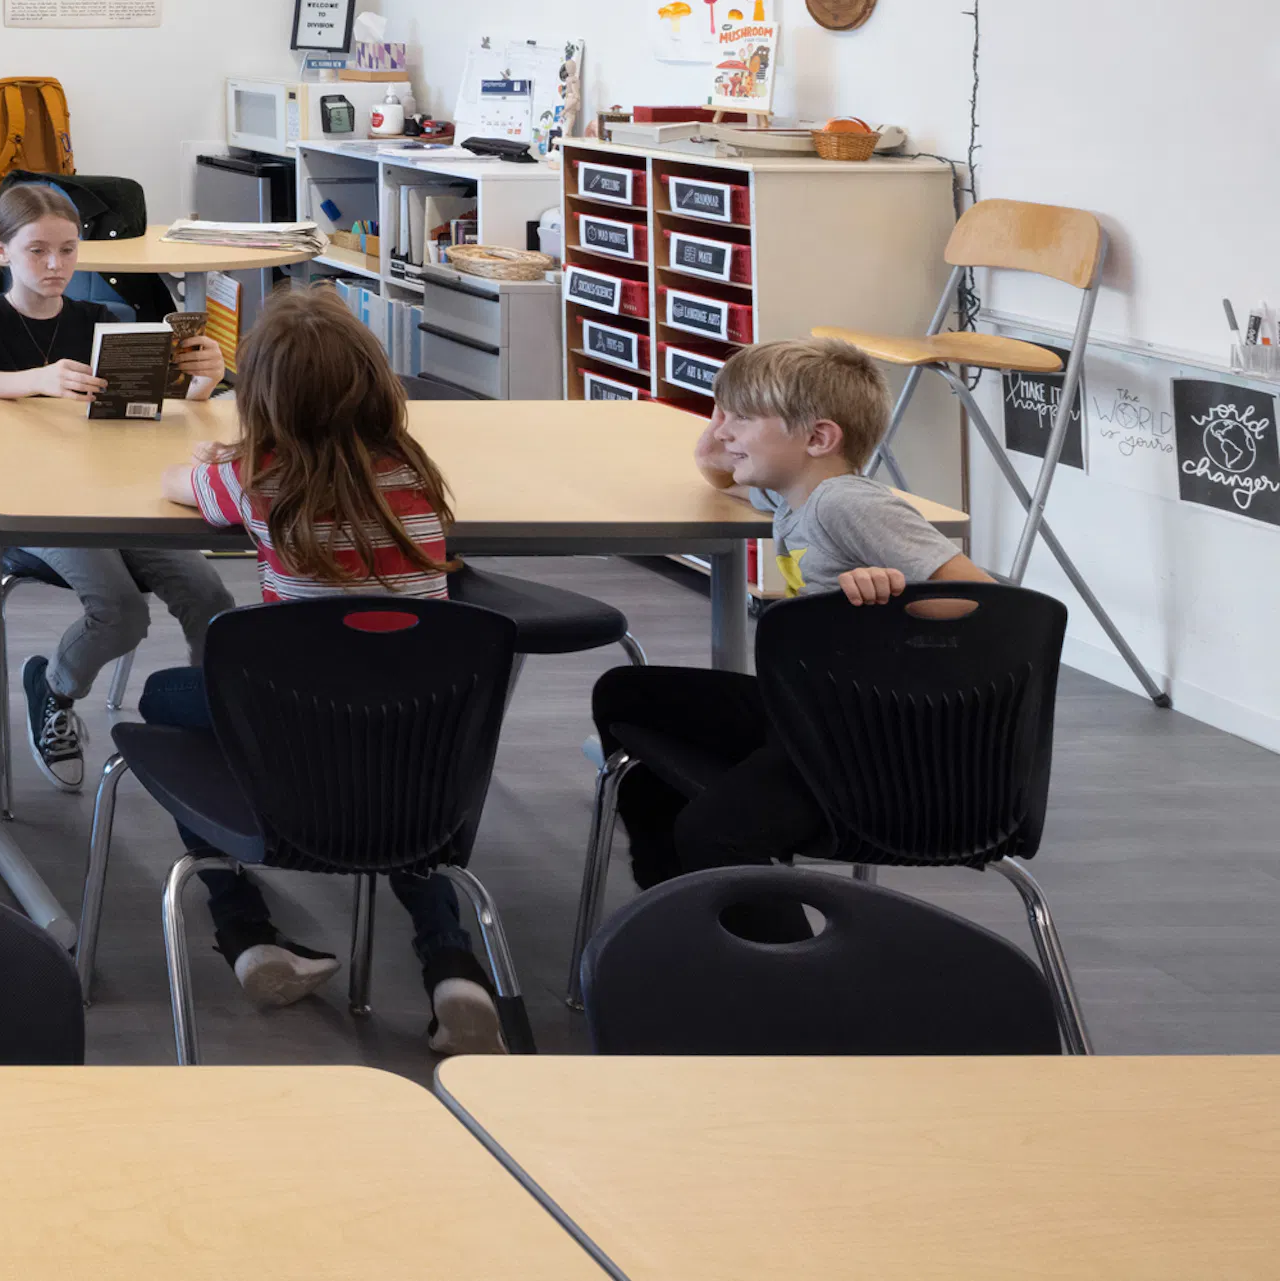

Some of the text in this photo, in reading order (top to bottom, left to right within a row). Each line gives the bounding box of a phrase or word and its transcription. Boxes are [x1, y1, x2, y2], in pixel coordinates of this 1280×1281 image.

[719, 26, 773, 43] MUSHROOM
[601, 178, 620, 191] SPELLING
[694, 192, 720, 208] GRAMMAR
[698, 250, 712, 264] MATH
[687, 365, 696, 378] ART
[1020, 380, 1062, 404] MAKE IT
[1116, 389, 1139, 402] The
[1093, 396, 1172, 437] WORLD
[1190, 404, 1269, 440] world
[1101, 428, 1120, 438] is
[1119, 436, 1173, 456] yours
[1182, 456, 1280, 509] changer
